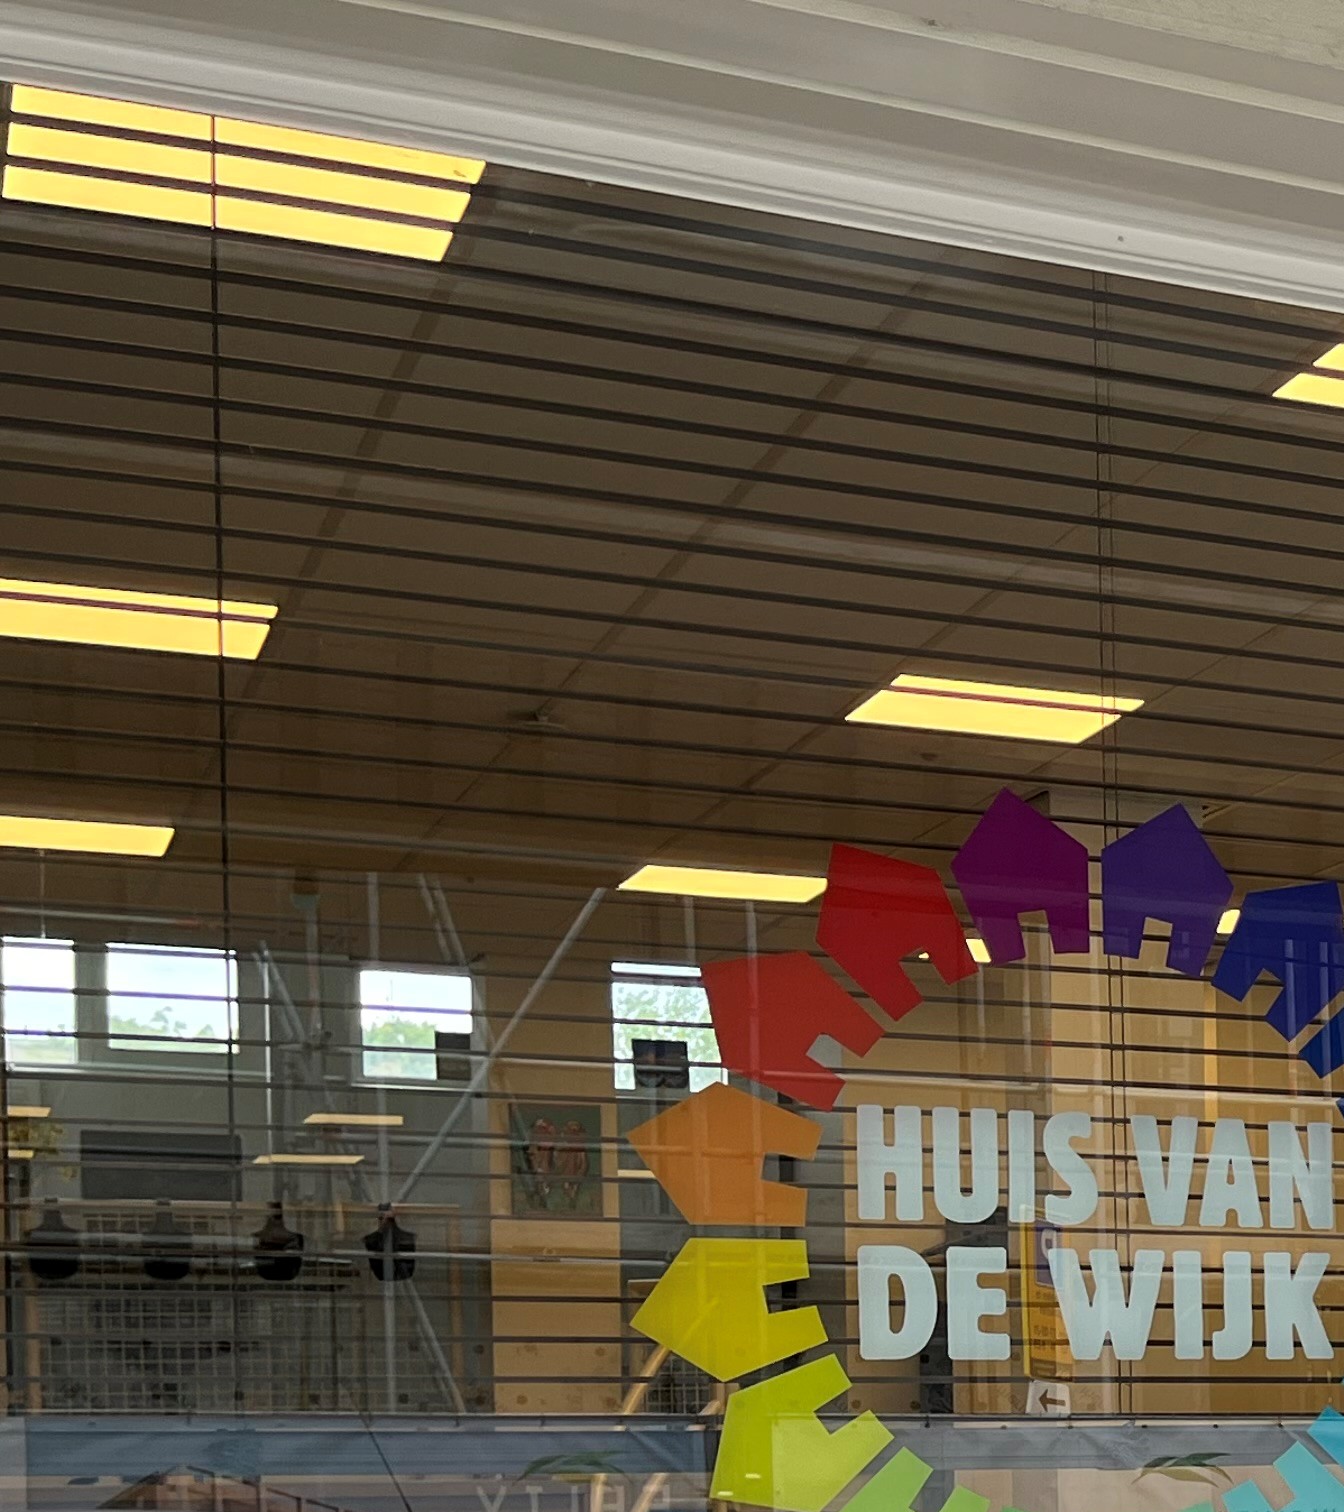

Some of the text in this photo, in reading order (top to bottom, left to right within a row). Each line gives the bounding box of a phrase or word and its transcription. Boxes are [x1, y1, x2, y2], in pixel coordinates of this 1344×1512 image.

[856, 1104, 1334, 1229] HUIS VAN
[857, 1244, 1011, 1361] DE
[1049, 1249, 1334, 1361] WIJK
